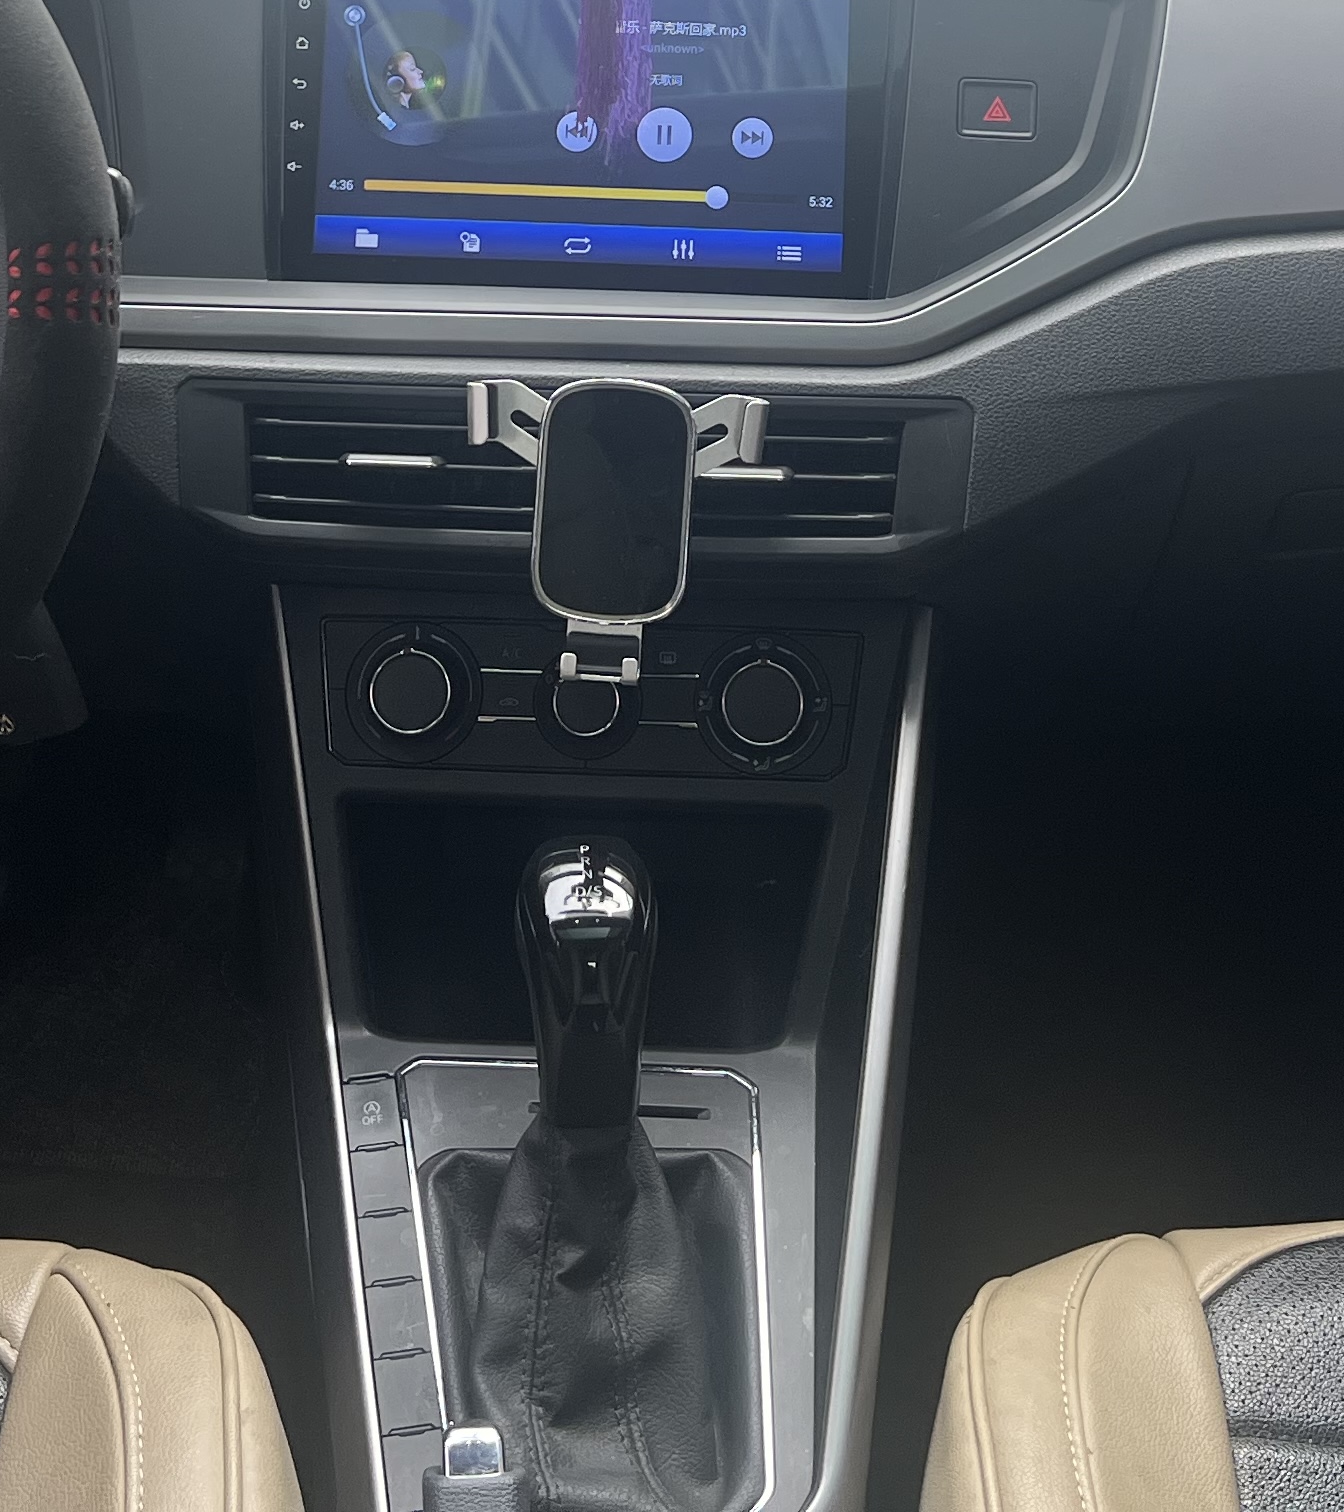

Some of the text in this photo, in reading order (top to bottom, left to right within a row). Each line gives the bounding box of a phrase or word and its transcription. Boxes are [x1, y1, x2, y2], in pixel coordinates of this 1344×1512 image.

[329, 179, 354, 191] 4:36
[809, 196, 833, 208] 5:32
[502, 647, 522, 658] A/C
[580, 844, 590, 854] P
[580, 856, 591, 866] R
[582, 869, 593, 879] N
[575, 885, 603, 898] D/S
[362, 1114, 383, 1126] OFF
